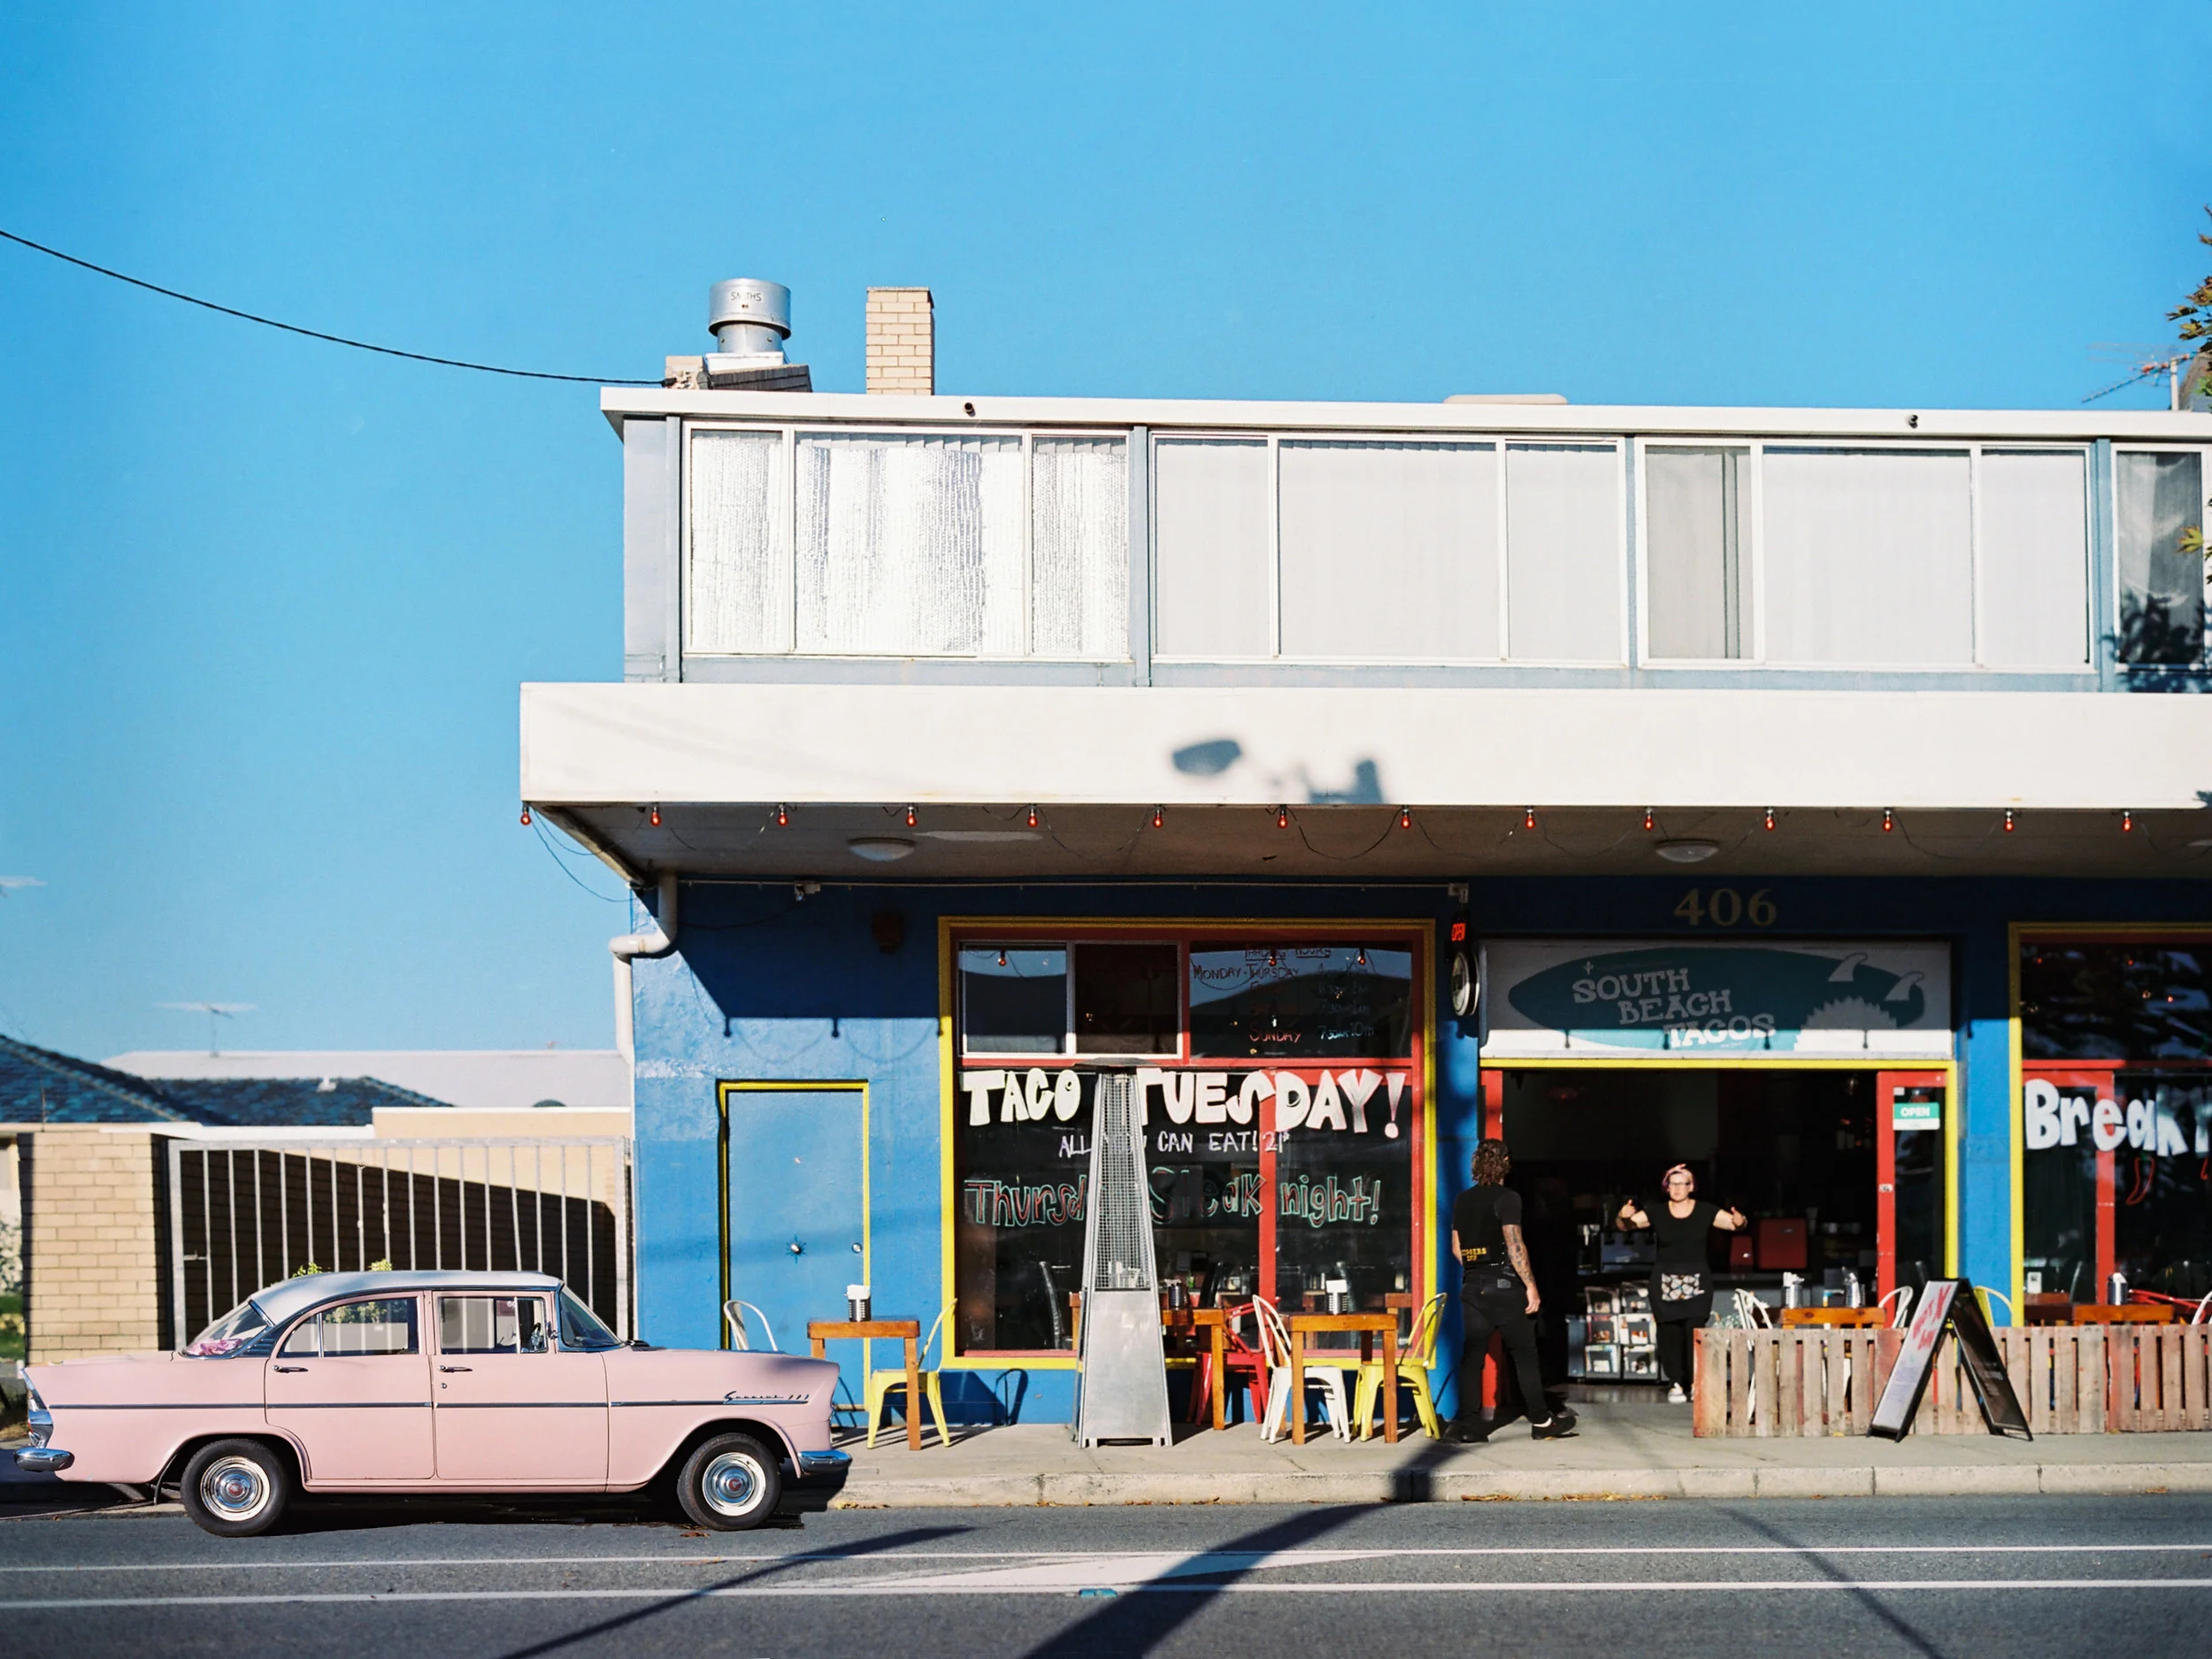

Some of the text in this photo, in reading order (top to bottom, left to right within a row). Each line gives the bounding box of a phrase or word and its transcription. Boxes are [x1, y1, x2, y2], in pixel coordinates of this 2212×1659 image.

[1673, 887, 1777, 926] 406
[1572, 968, 1690, 1003] SOUTH
[1617, 989, 1732, 1025] BEACH
[1663, 1013, 1776, 1048] TACOS
[962, 1068, 1407, 1139] TACO TUESDAY!
[1901, 1106, 1931, 1118] OPEN
[1157, 1131, 1193, 1153] CAN
[1208, 1130, 1258, 1153] EAT!
[964, 1175, 1088, 1227] Thursd
[1280, 1175, 1381, 1229] night!
